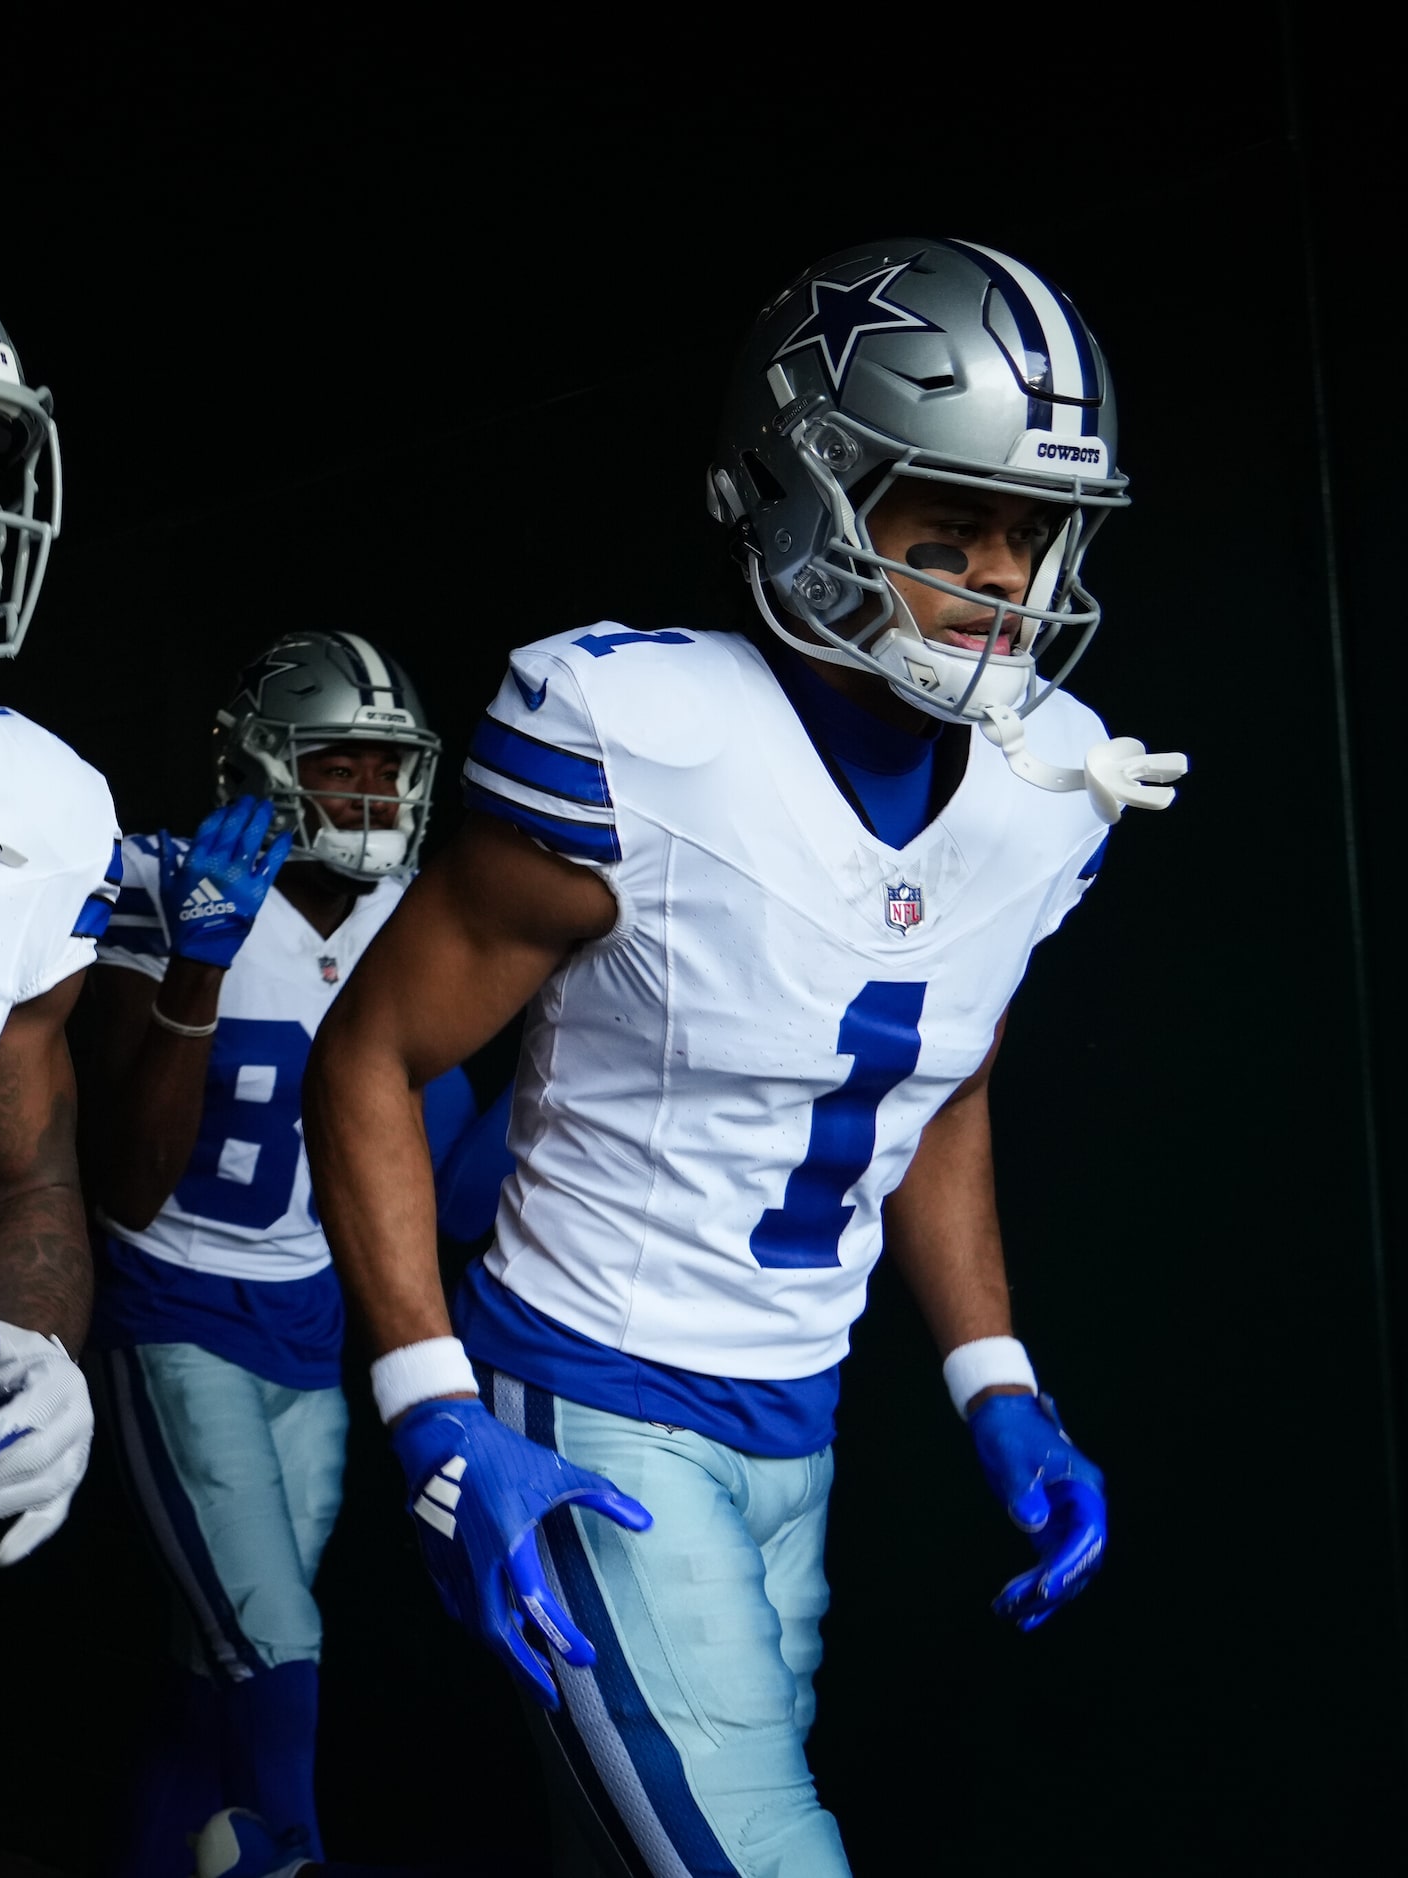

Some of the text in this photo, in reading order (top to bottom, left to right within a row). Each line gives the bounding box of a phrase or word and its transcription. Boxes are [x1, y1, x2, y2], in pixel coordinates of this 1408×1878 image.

[1037, 442, 1100, 464] COWBOYS
[570, 631, 696, 658] 1
[178, 901, 236, 921] adidas
[892, 903, 919, 924] NFL
[749, 980, 928, 1268] 1
